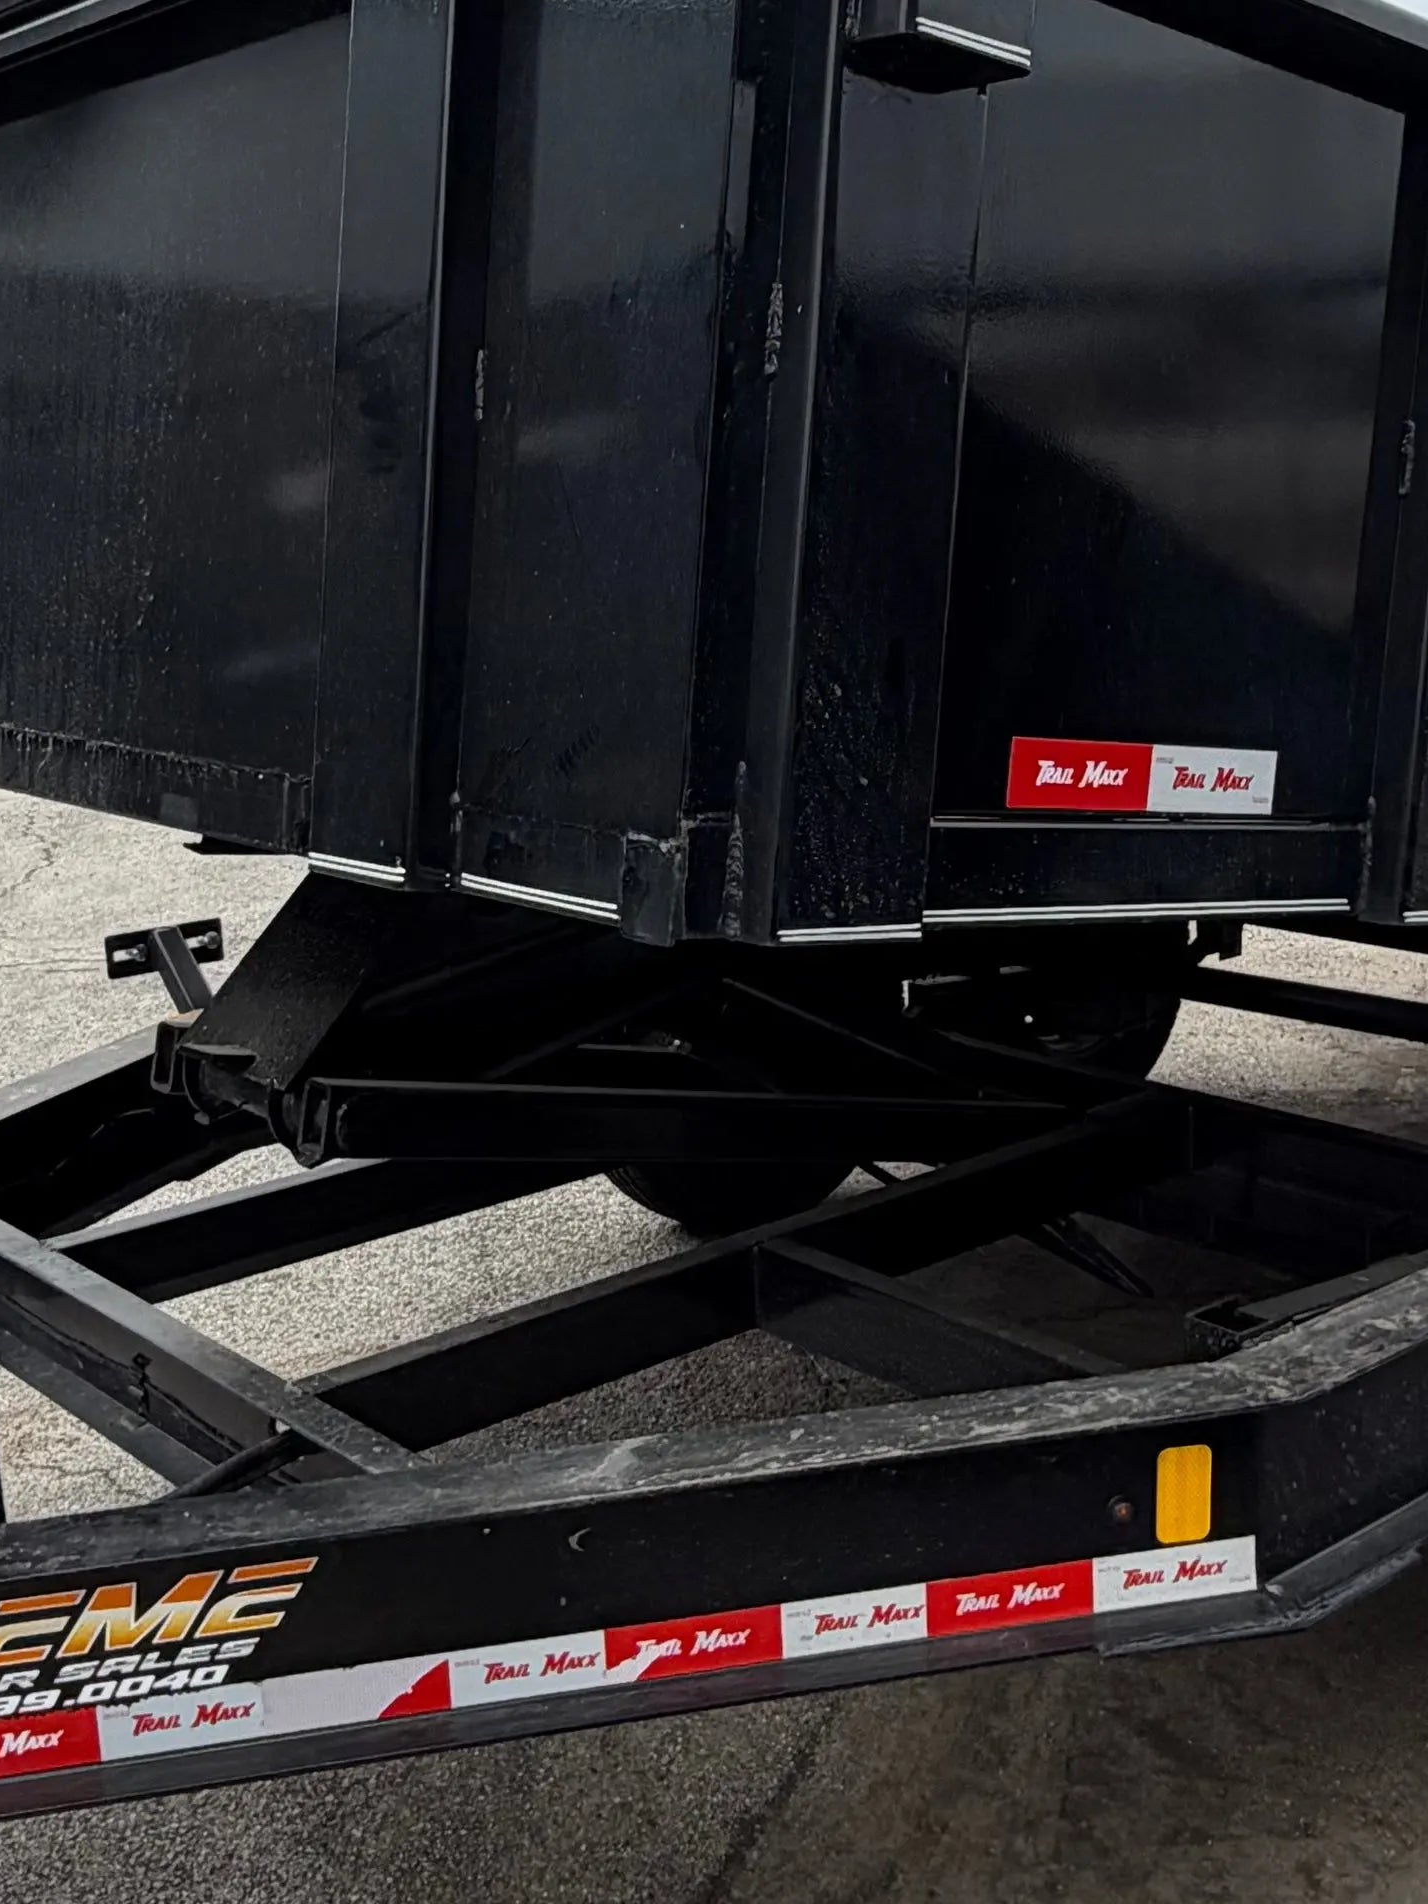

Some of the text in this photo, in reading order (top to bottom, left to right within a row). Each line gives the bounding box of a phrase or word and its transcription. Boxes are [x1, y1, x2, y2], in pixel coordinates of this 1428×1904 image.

[1036, 760, 1128, 788] TRAIL MAXX
[1172, 767, 1254, 792] TRAIL MAXX
[1123, 1558, 1228, 1590] TRAIL MAXX
[956, 1582, 1066, 1616] TRAIL MAXX
[815, 1613, 858, 1635] TRAIL
[868, 1603, 924, 1627] MAXX
[690, 1628, 751, 1656] MAXX
[55, 1637, 261, 1683] SALES
[484, 1651, 601, 1684] TRAIL MAXX
[132, 1702, 256, 1736] TRAIL MAXX
